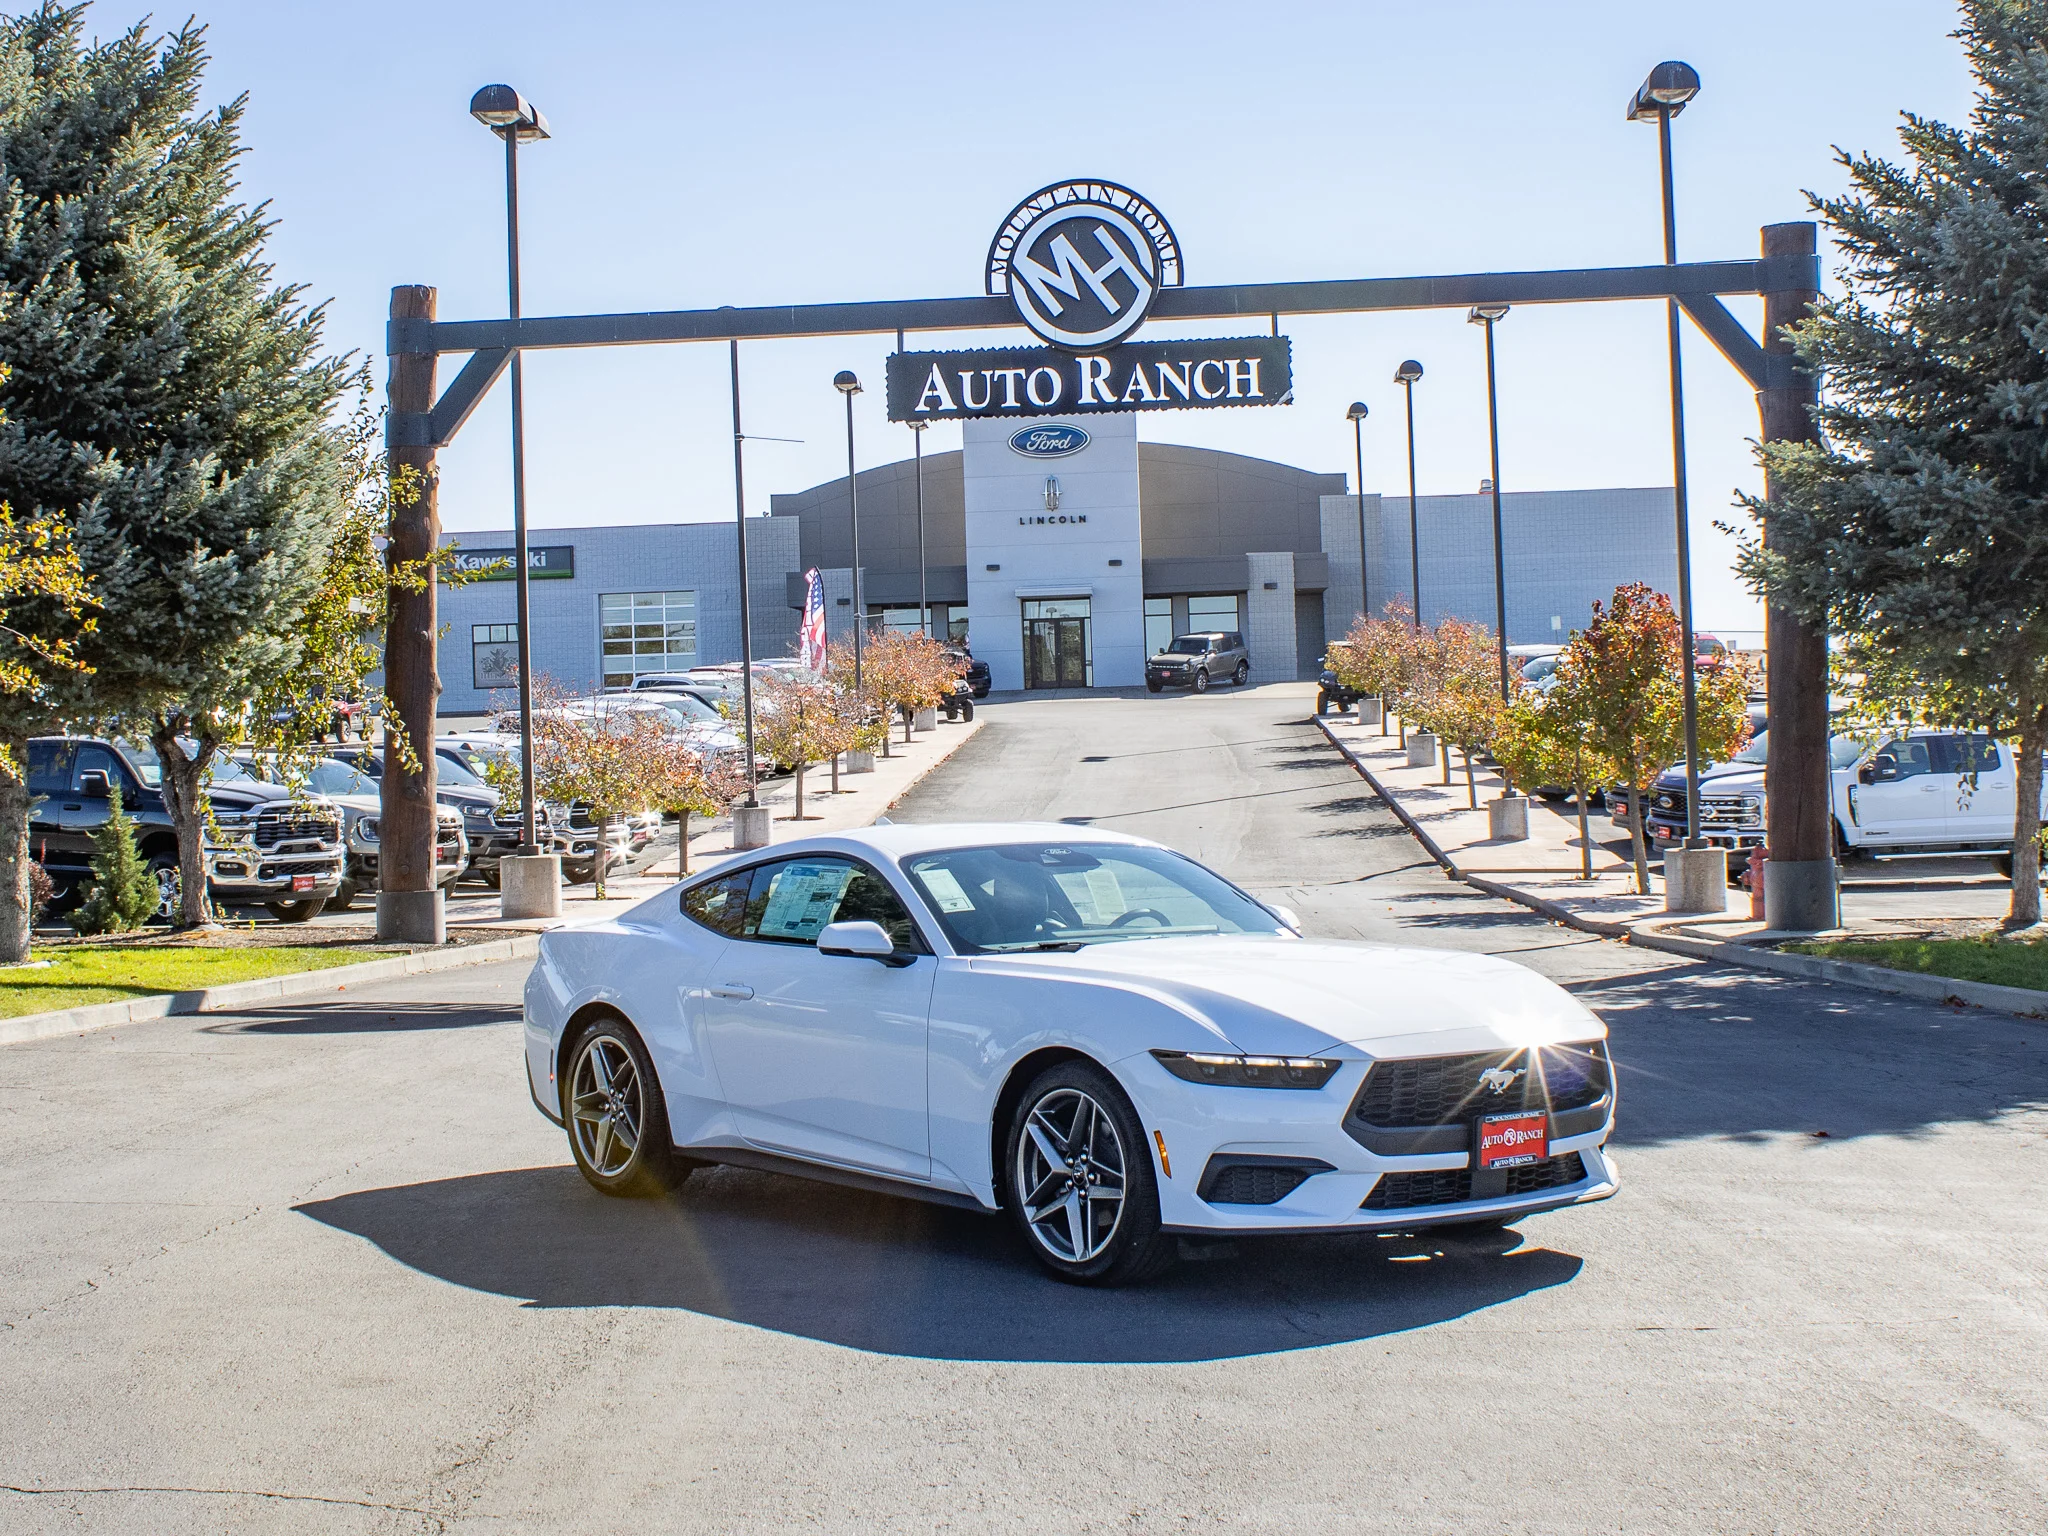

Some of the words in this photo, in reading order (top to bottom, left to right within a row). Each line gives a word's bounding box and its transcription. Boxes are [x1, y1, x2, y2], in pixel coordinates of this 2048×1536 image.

[991, 184, 1116, 275] MOUNTAIN
[1123, 198, 1178, 270] HOME
[914, 362, 1063, 413] AUTO
[1074, 355, 1265, 405] RANCH
[1026, 431, 1073, 451] Ford
[1019, 515, 1087, 526] LINCOLN
[455, 551, 547, 571] Kawski
[1481, 1135, 1503, 1149] AUTO
[1516, 1129, 1543, 1144] RANCH
